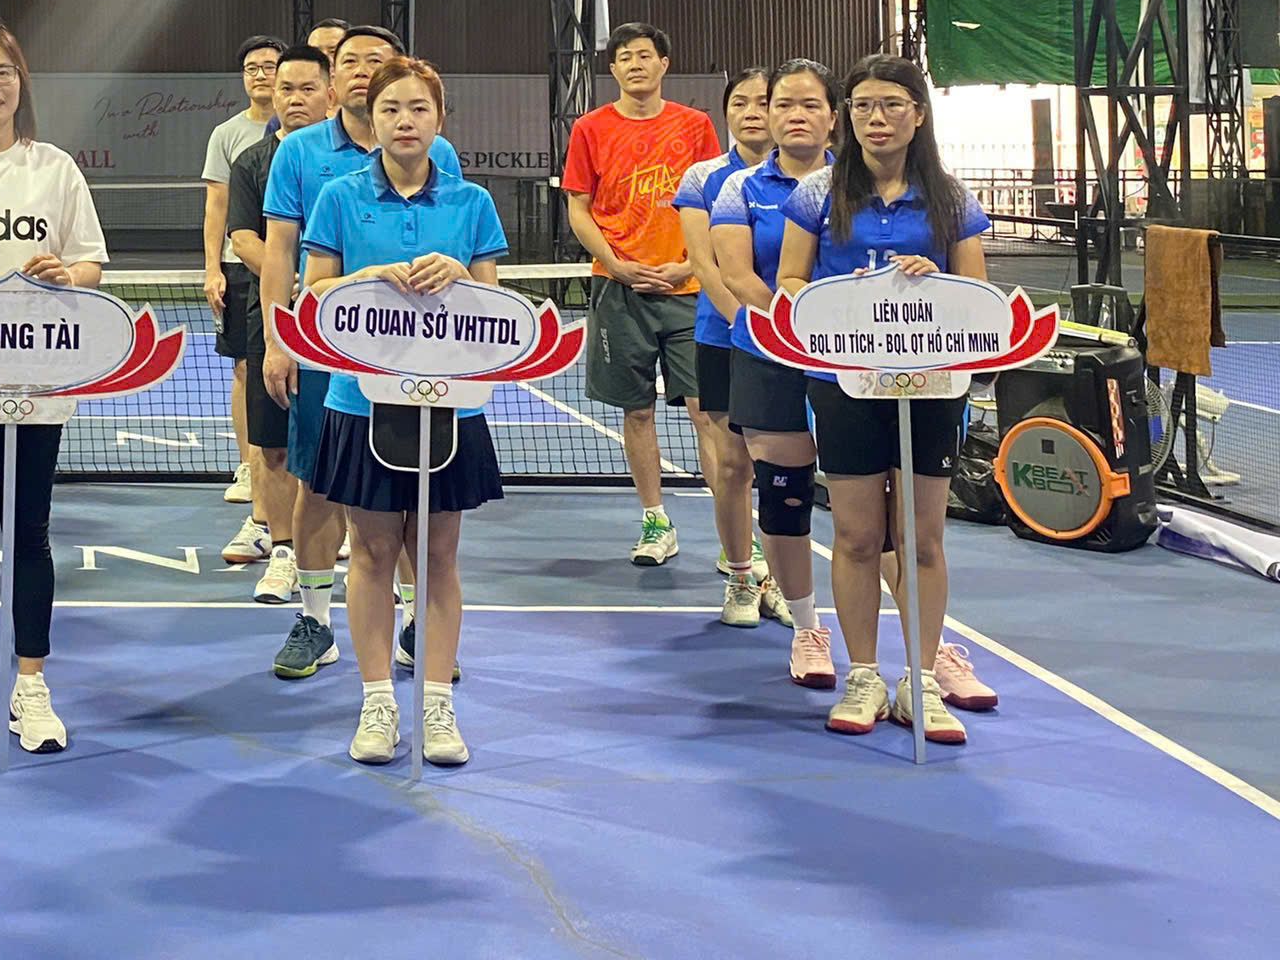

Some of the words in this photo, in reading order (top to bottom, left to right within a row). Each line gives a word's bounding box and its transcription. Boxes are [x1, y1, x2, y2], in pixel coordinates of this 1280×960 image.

[75, 149, 116, 169] ALL
[474, 151, 550, 168] PICKLE
[334, 304, 361, 333] CƠ
[365, 307, 416, 337] QUAN
[422, 304, 449, 340] SỞ
[453, 314, 520, 346] VHTTDL
[873, 298, 899, 323] LIÊN
[902, 298, 933, 325] QUÂN
[42, 318, 80, 350] TÀI
[810, 334, 831, 355] BQL
[835, 333, 846, 353] DI
[849, 329, 875, 354] TÍCH
[886, 333, 907, 356] BQL
[910, 333, 924, 356] QT
[927, 326, 942, 353] HỒ
[945, 328, 965, 353] CHÍ
[968, 332, 1000, 353] MINH
